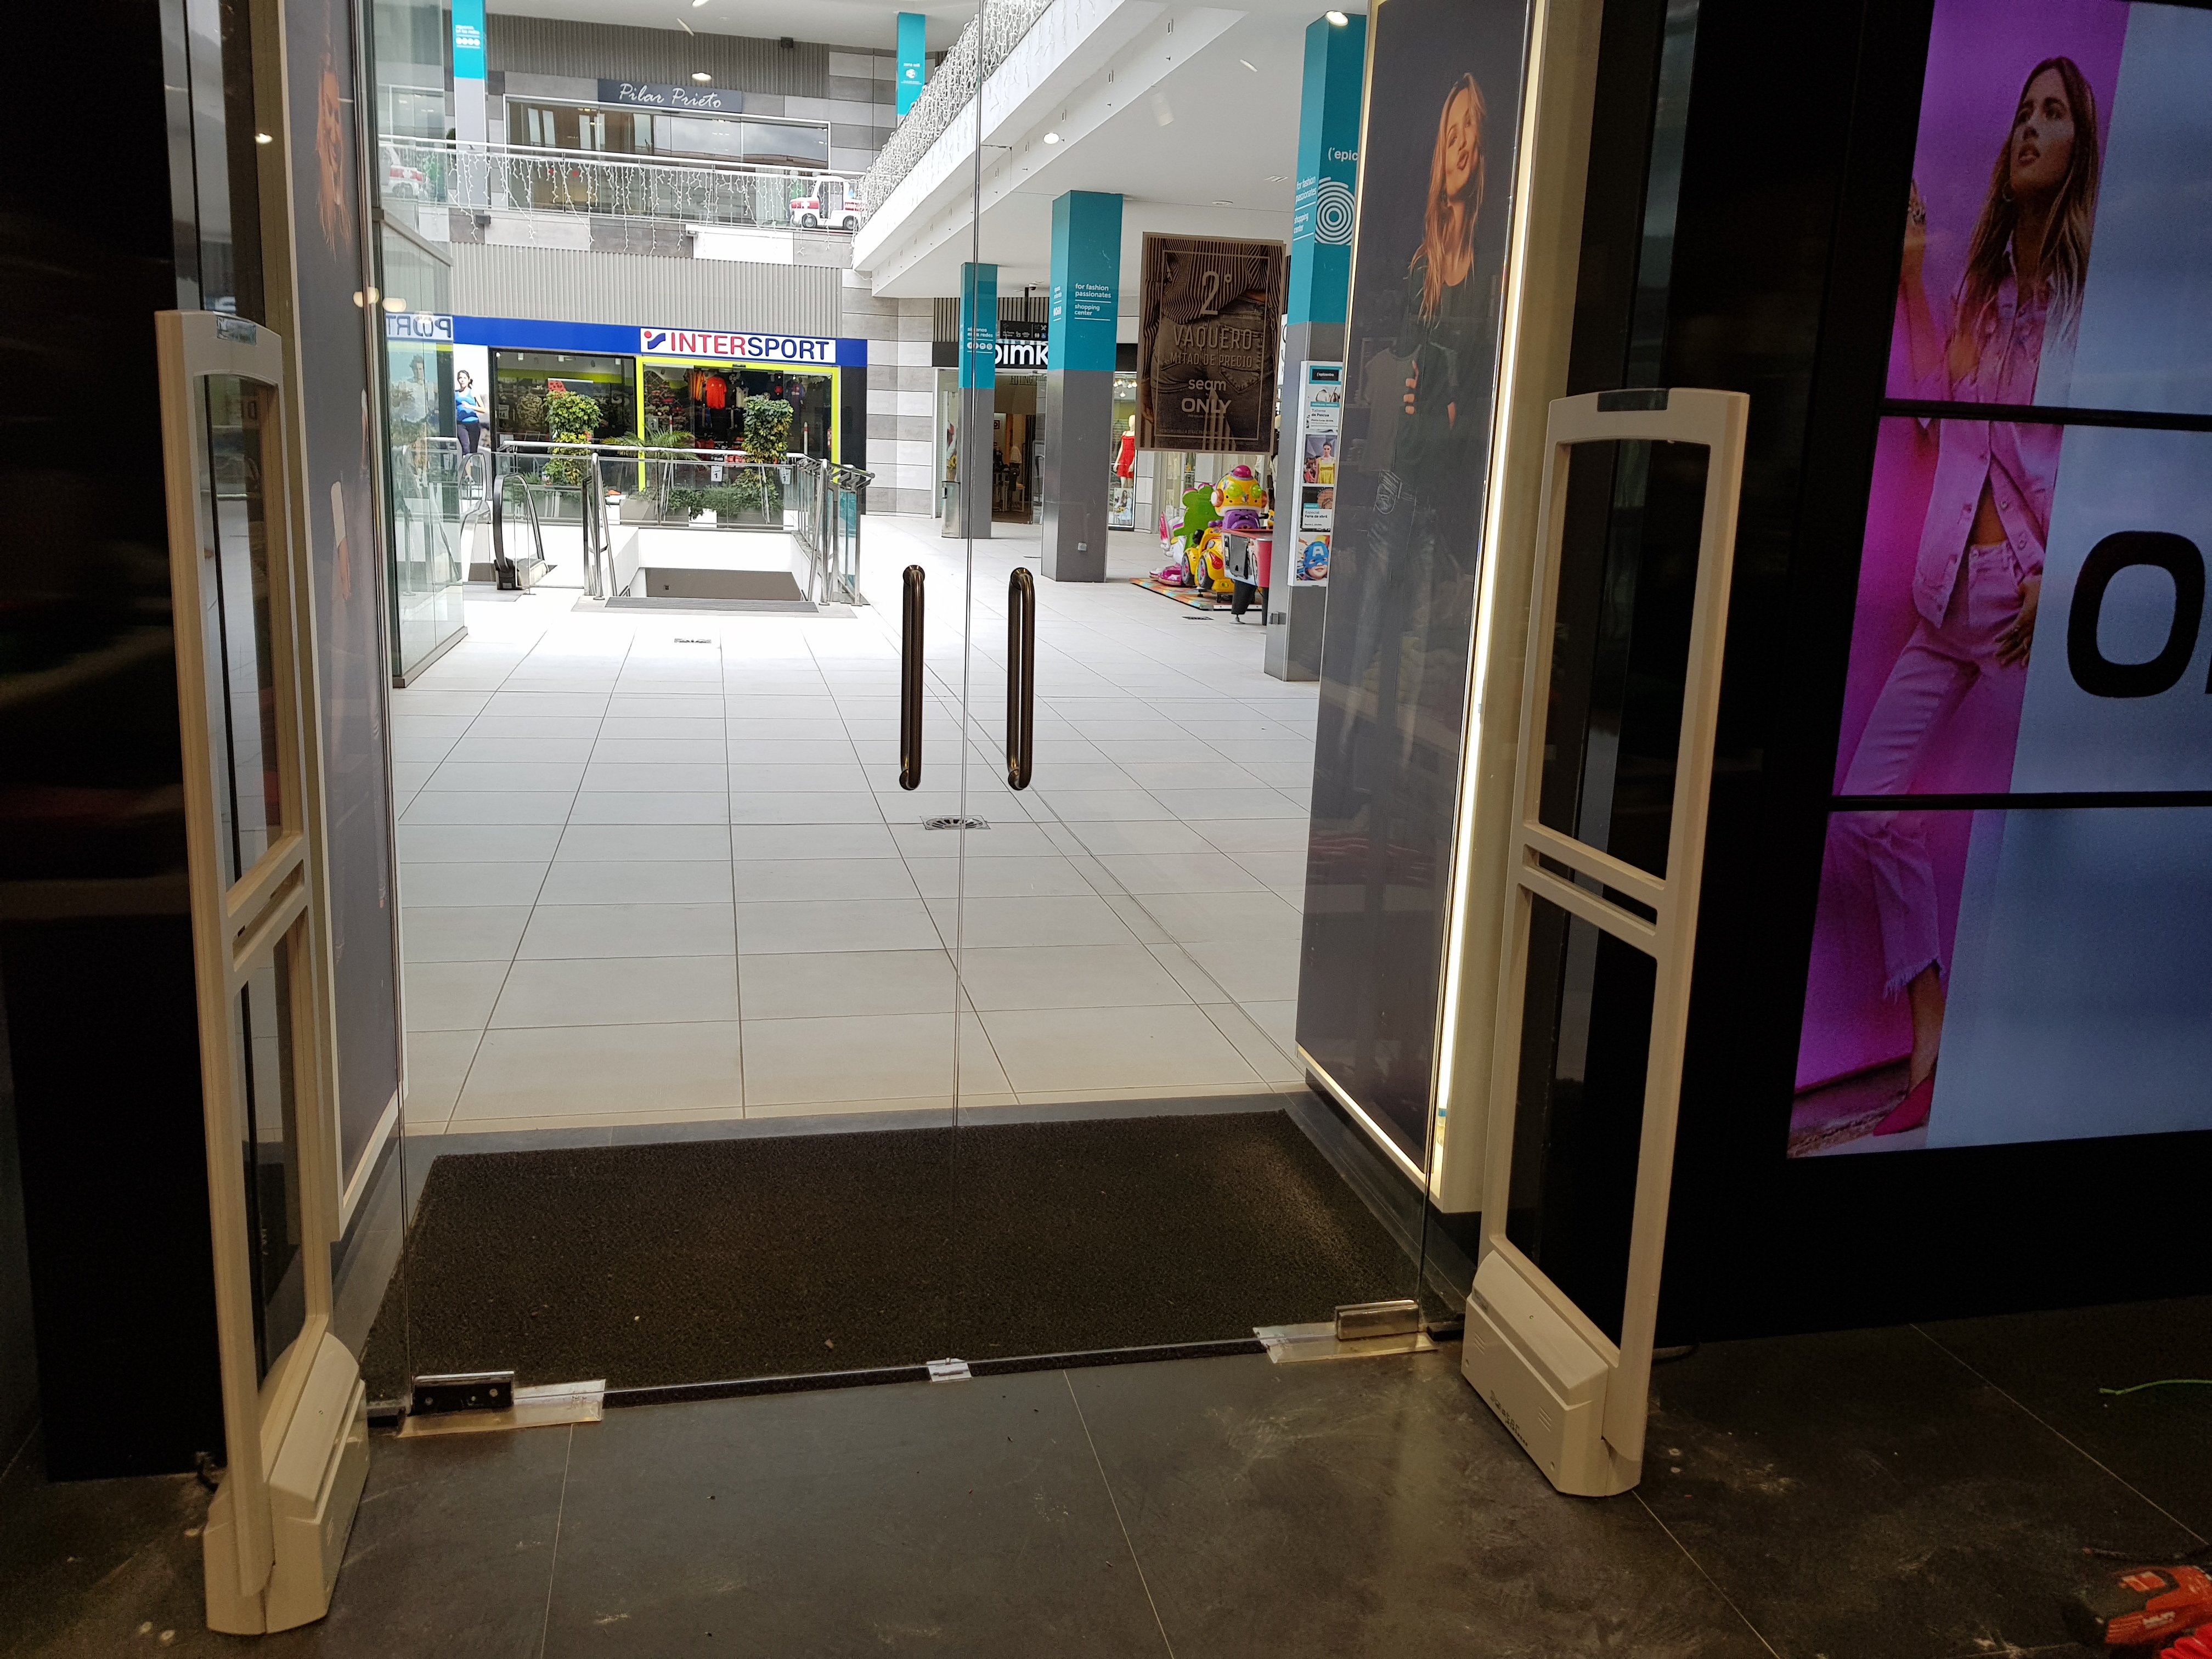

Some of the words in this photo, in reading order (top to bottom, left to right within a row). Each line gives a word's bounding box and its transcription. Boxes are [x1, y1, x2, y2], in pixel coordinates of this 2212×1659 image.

[619, 83, 664, 104] Pilar
[672, 87, 721, 108] Prieto
[1302, 176, 1316, 188] fashion
[1296, 188, 1316, 205] passionates
[1294, 212, 1308, 224] shopping
[671, 332, 830, 360] INTERSPORT
[1173, 325, 1251, 351] VAQUERO
[1171, 352, 1199, 365] MITAD
[1204, 354, 1215, 365] DE
[1219, 354, 1252, 368] PRECIO
[1188, 379, 1227, 391] seam
[1181, 398, 1232, 414] ONLY
